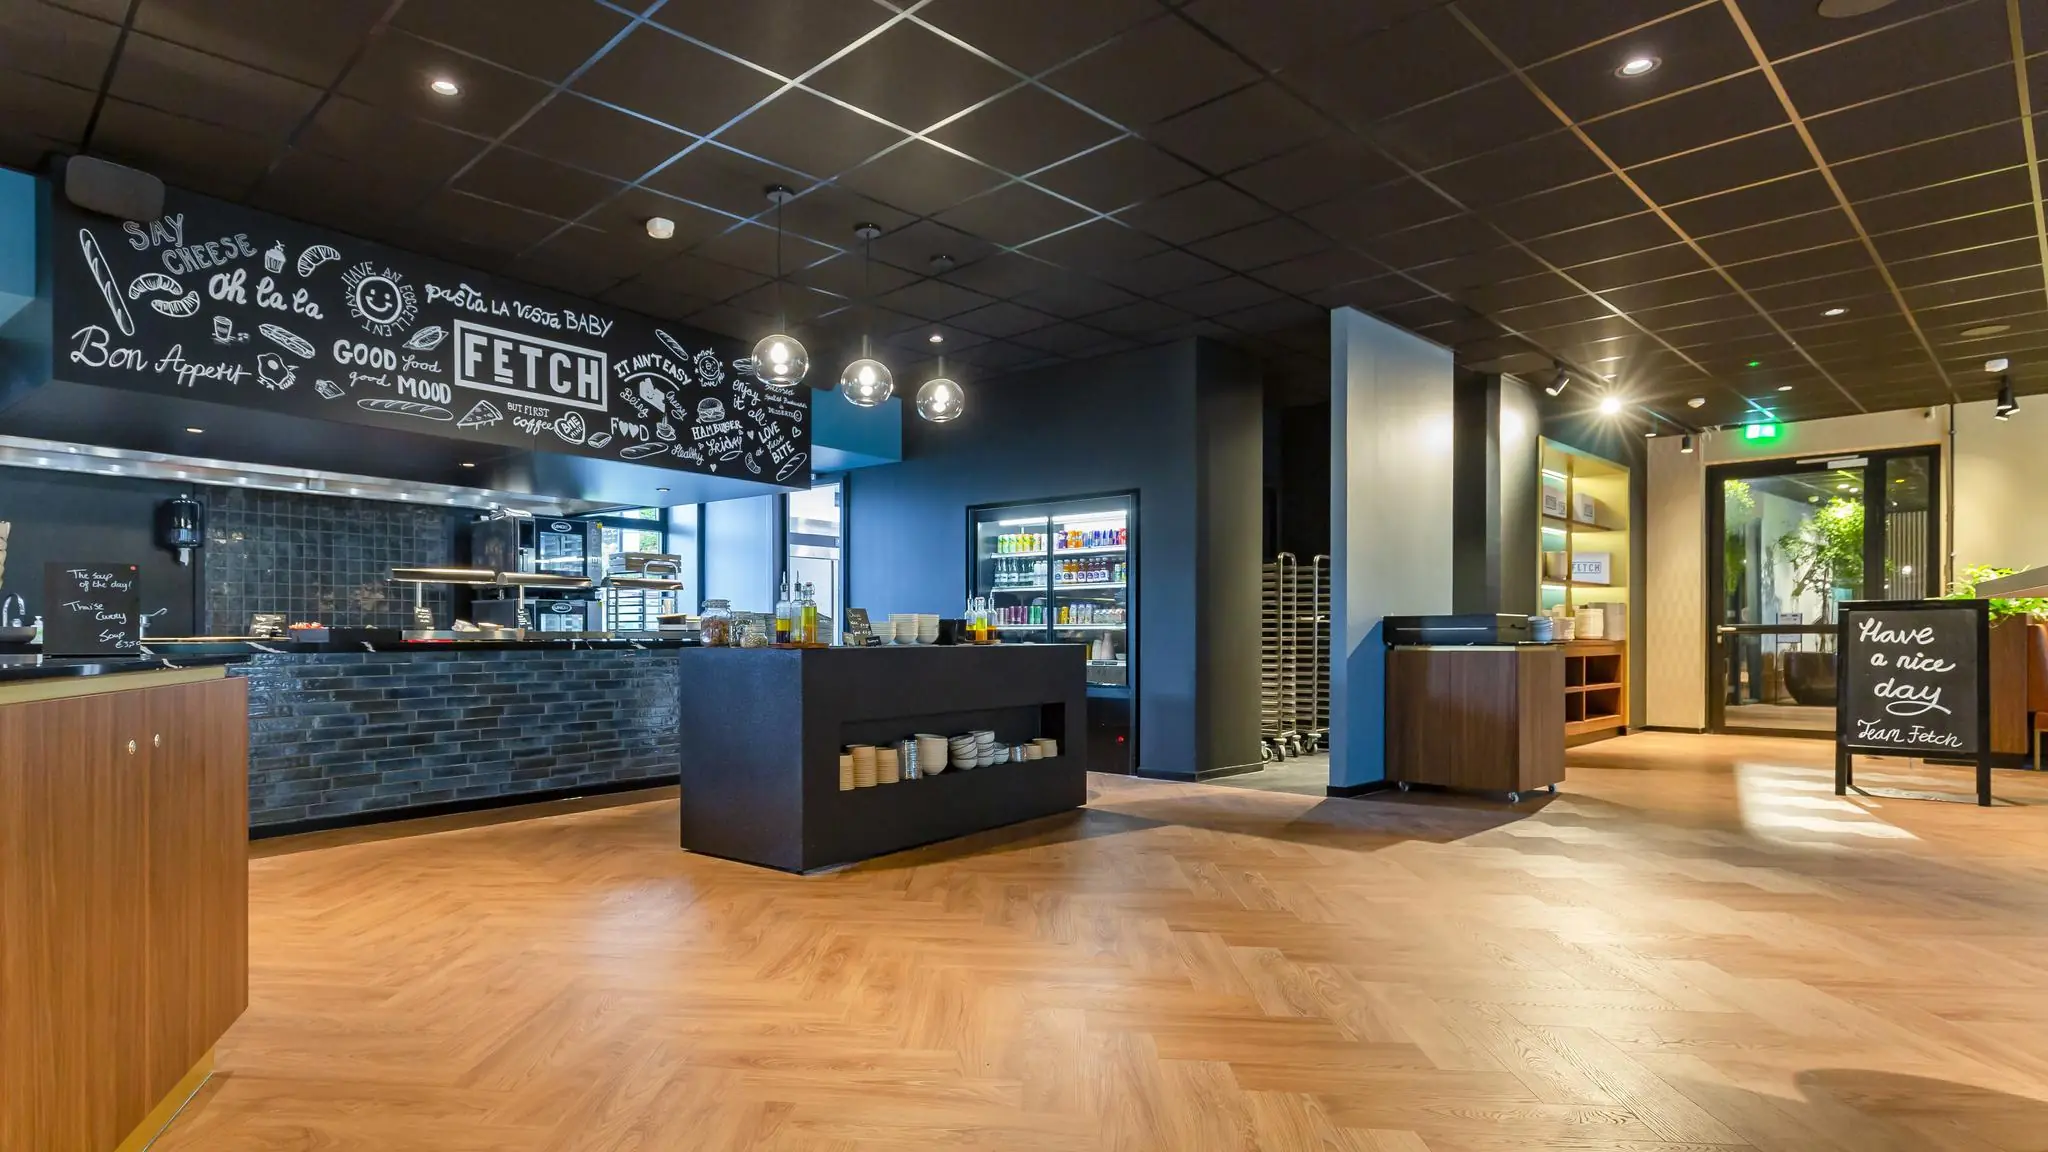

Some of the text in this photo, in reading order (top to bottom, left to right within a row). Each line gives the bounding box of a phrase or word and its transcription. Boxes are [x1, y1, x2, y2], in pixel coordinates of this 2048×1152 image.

[123, 213, 184, 250] SAY
[162, 233, 258, 275] CHEESE
[341, 261, 376, 289] HAVE
[381, 267, 403, 283] AN
[208, 268, 324, 320] Oh la la
[491, 299, 510, 317] LA
[563, 310, 614, 338] BABY
[70, 325, 252, 388] Bon Appetit
[333, 339, 443, 373] GOOD food
[464, 332, 599, 401] FETCH
[613, 359, 631, 379] IT
[662, 359, 692, 386] EASY
[349, 371, 452, 404] good MOOD
[732, 379, 761, 406] enjoy
[507, 402, 550, 418] BUT FIRST
[620, 387, 649, 419] Being
[733, 394, 746, 411] it
[513, 416, 555, 436] coffee
[690, 419, 743, 441] HAMBURGER
[758, 421, 781, 444] LOVE
[771, 440, 796, 464] BITE
[66, 569, 114, 582] The soup
[79, 580, 90, 593] of
[92, 581, 108, 589] the
[95, 611, 127, 625] Curry
[1858, 617, 1935, 645] Have
[99, 628, 126, 643] Soup
[1870, 652, 1957, 672] a nice
[1873, 677, 1952, 717] day
[1857, 718, 1963, 748] Team Fetch
